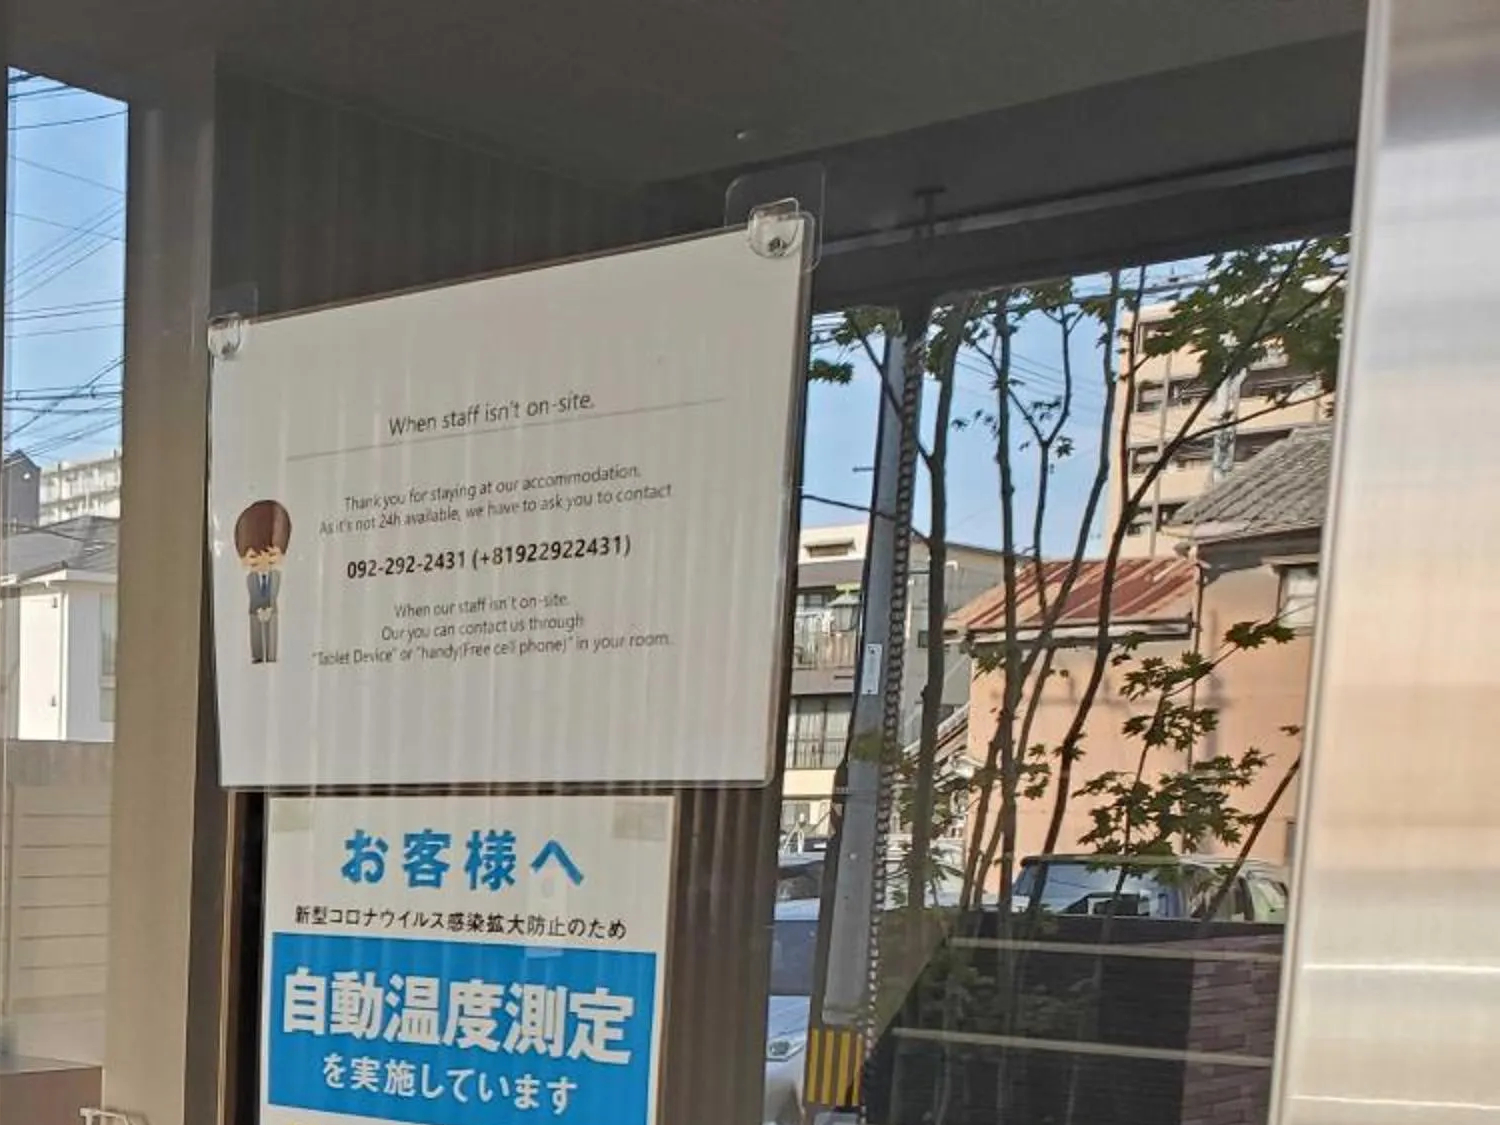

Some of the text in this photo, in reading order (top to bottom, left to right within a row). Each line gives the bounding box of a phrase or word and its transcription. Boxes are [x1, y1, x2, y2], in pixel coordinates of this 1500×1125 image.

[388, 392, 595, 436] When staff isn't on-site.
[319, 521, 334, 535] As
[355, 517, 376, 532] not
[379, 511, 401, 528] 24h
[465, 506, 484, 518] we
[487, 501, 519, 517] have
[522, 499, 537, 513] to
[540, 494, 563, 511] ask
[564, 495, 593, 512] you
[597, 490, 613, 505] to
[615, 483, 673, 503] contact
[344, 495, 380, 512] Thank
[381, 495, 405, 510] you
[409, 487, 429, 504] for
[430, 483, 477, 502] staying
[479, 481, 492, 495] at
[495, 480, 519, 493] our
[347, 534, 632, 579] 092-292-2431 (+81922922431)
[381, 612, 584, 644] Our you can contact us through
[393, 603, 430, 619] When
[433, 603, 456, 616] our
[458, 597, 487, 614] staff
[489, 595, 517, 611] isn't
[575, 636, 589, 650] in
[593, 635, 625, 653] your
[342, 828, 585, 892] お客様へ
[295, 904, 627, 940] 新型コロナウイルス感染拡大防止のため
[283, 966, 635, 1065] 自動温度測定
[322, 1053, 578, 1116] を実施しています
